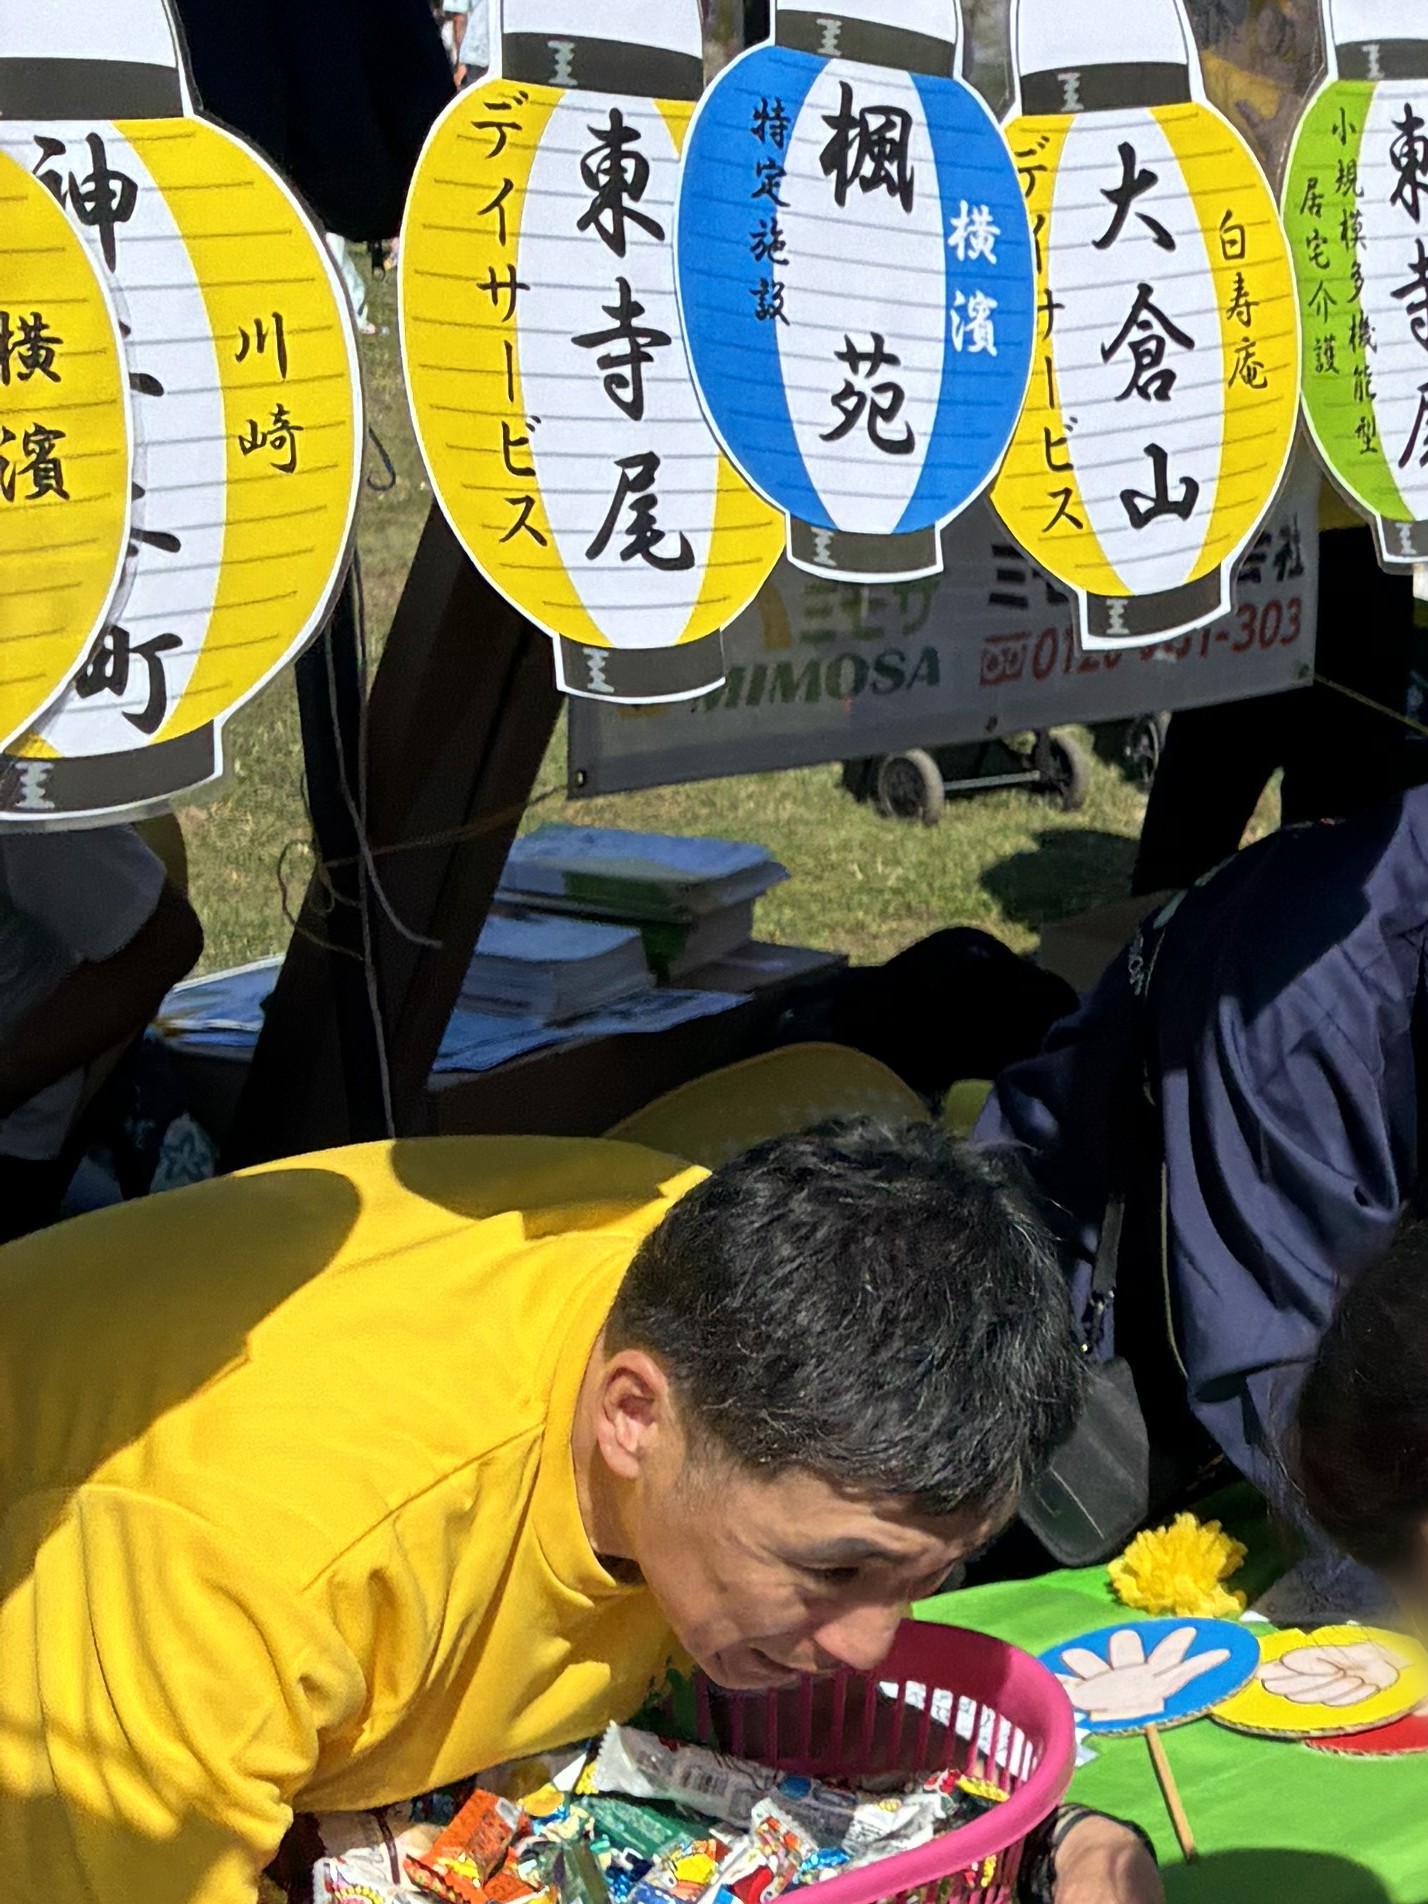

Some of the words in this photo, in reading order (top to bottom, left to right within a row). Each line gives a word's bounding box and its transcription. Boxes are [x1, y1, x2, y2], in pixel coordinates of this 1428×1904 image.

[471, 89, 548, 549] デイサービス
[572, 108, 694, 572] 東寺尾
[751, 97, 791, 326] 特定施設
[820, 82, 916, 456] 楓苑
[948, 199, 1000, 358] 横濱
[1091, 141, 1202, 530] 大倉山
[1218, 209, 1269, 390] 白寿庵
[1300, 177, 1340, 375] 居宅介護
[1332, 108, 1378, 455] 小規模多機能型
[235, 311, 304, 475] 川崎
